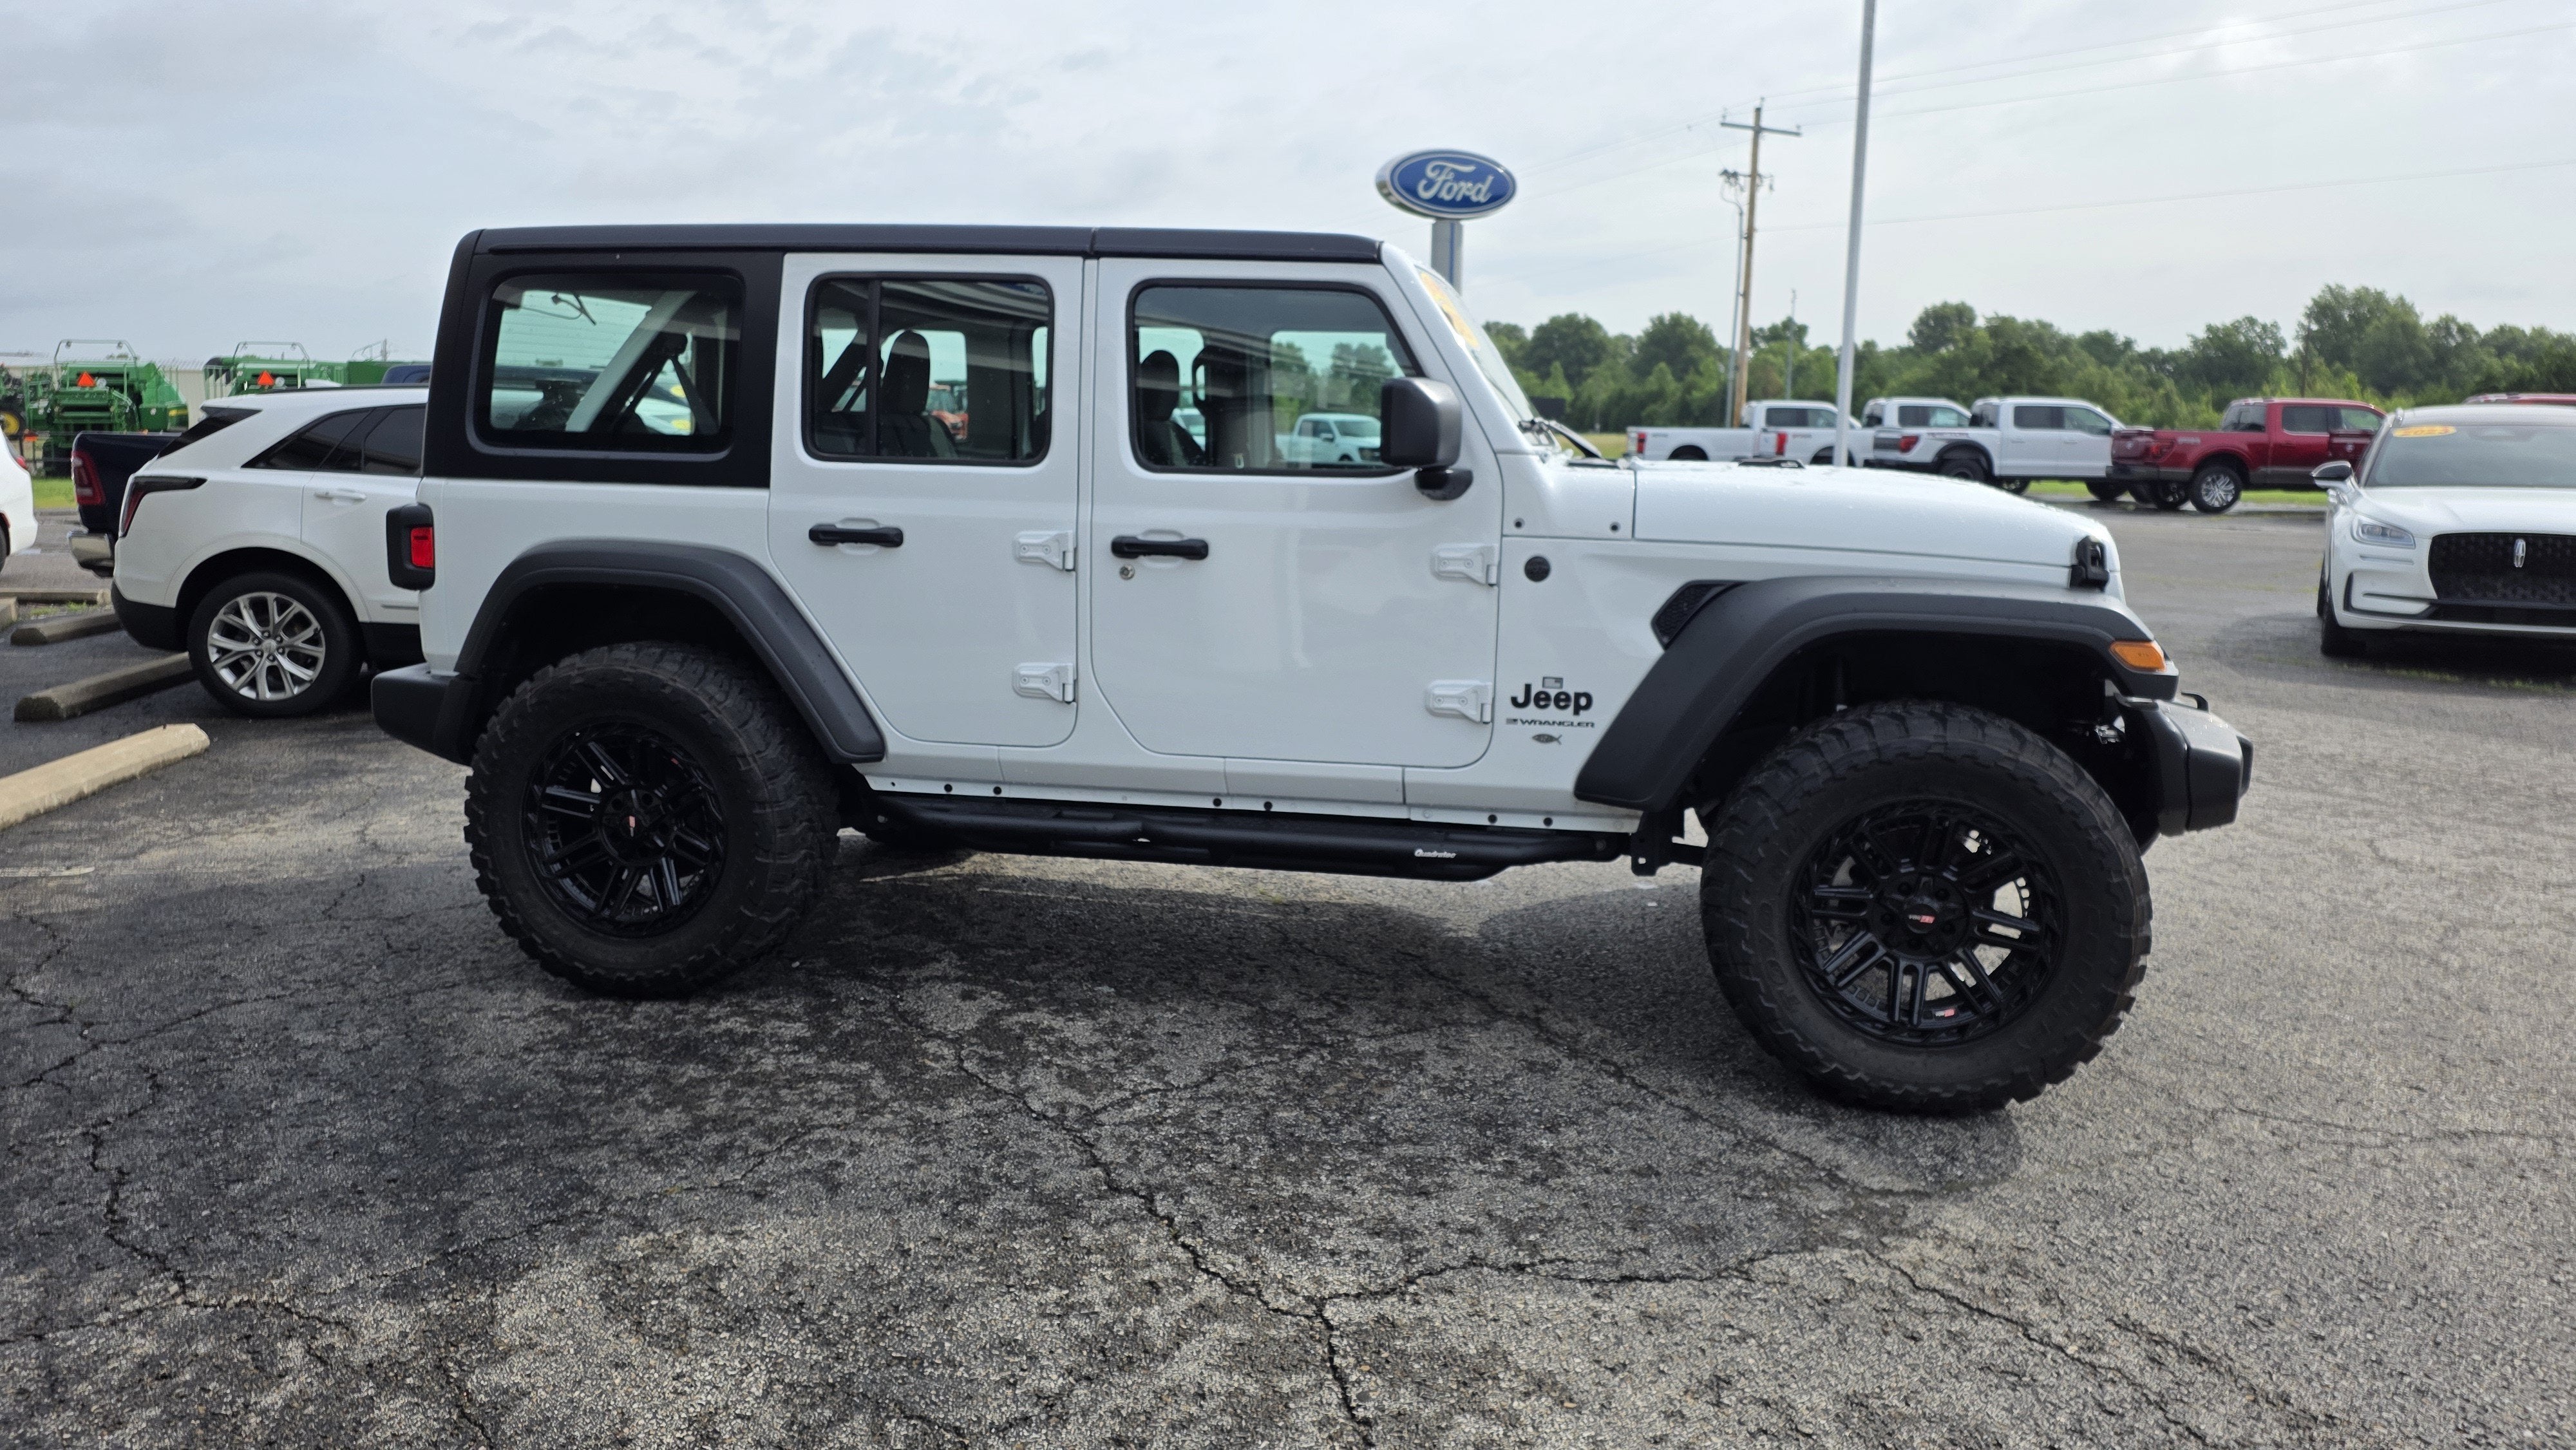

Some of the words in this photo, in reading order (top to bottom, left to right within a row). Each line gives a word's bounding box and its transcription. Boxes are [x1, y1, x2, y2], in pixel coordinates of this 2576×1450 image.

[1417, 160, 1495, 203] Ford
[1510, 683, 1593, 716] Jeep
[1519, 718, 1595, 728] WRANGLER
